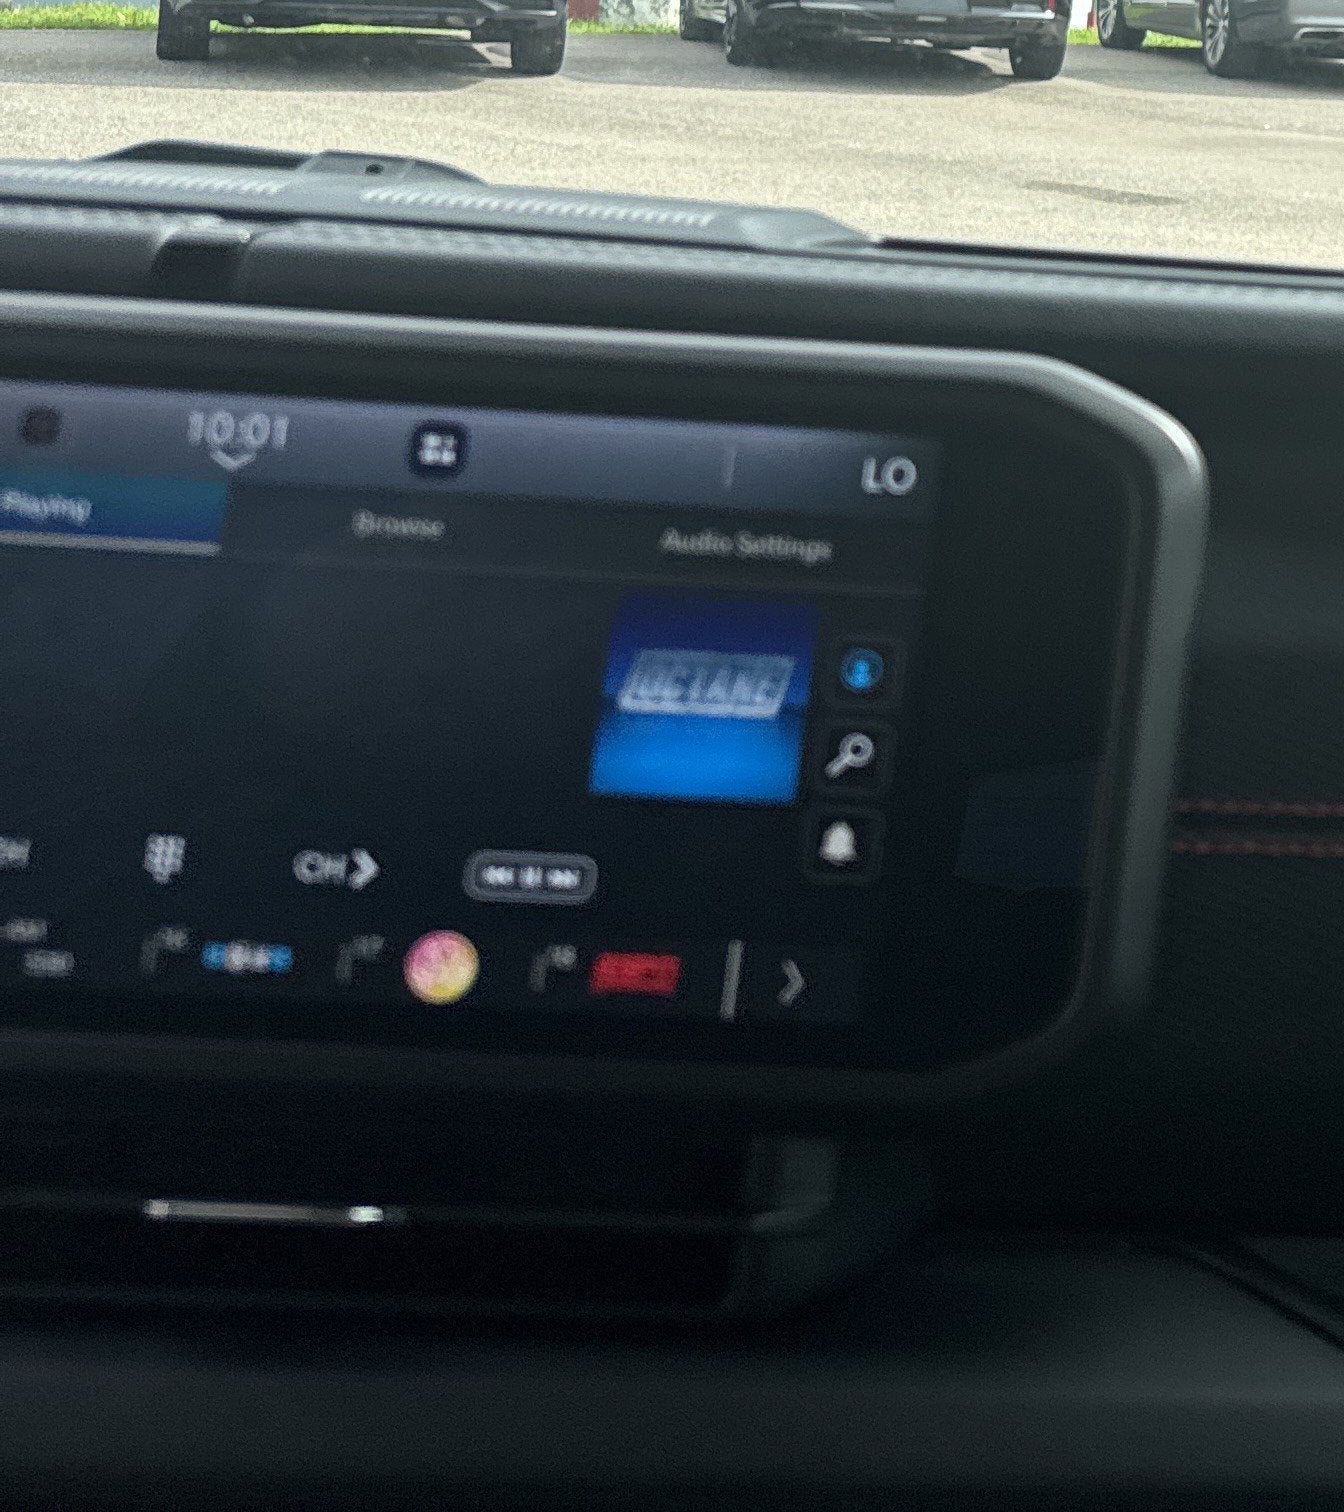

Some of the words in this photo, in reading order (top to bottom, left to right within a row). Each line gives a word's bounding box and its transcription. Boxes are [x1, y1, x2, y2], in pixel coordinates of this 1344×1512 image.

[187, 410, 290, 450] 10:01
[861, 456, 918, 496] LO
[351, 509, 446, 540] Browse
[658, 527, 733, 558] Audio
[736, 529, 834, 567] Settings
